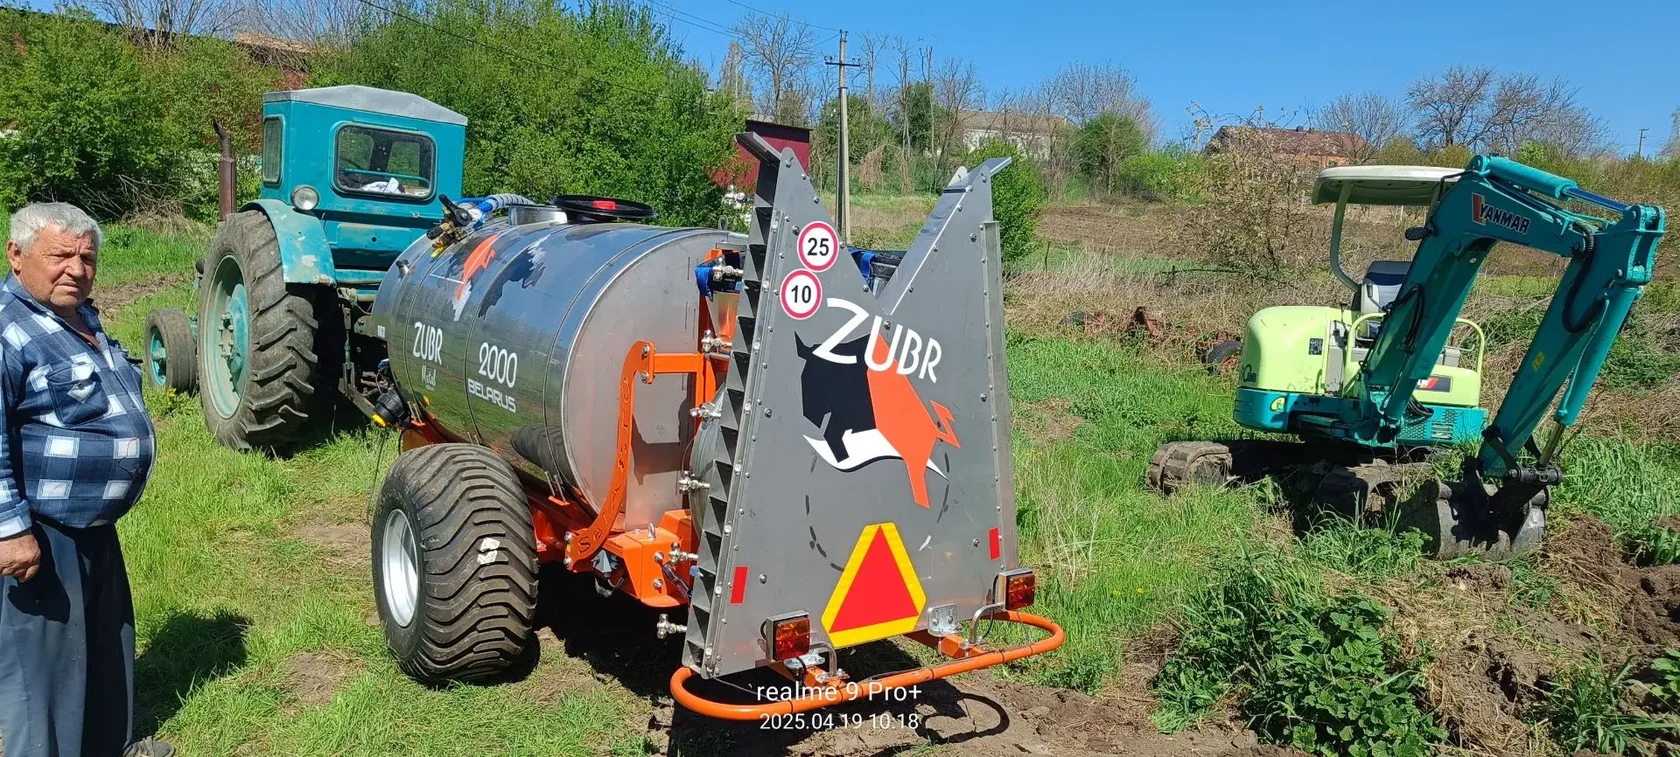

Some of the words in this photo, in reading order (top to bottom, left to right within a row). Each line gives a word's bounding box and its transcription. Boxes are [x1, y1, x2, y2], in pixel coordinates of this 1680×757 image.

[1480, 204, 1531, 234] YANMAR
[807, 237, 829, 256] 25
[791, 284, 811, 303] 10
[413, 322, 442, 365] ZUBR
[812, 297, 942, 384] ZUBR
[478, 342, 518, 388] 2000
[467, 378, 517, 413] BELARUS
